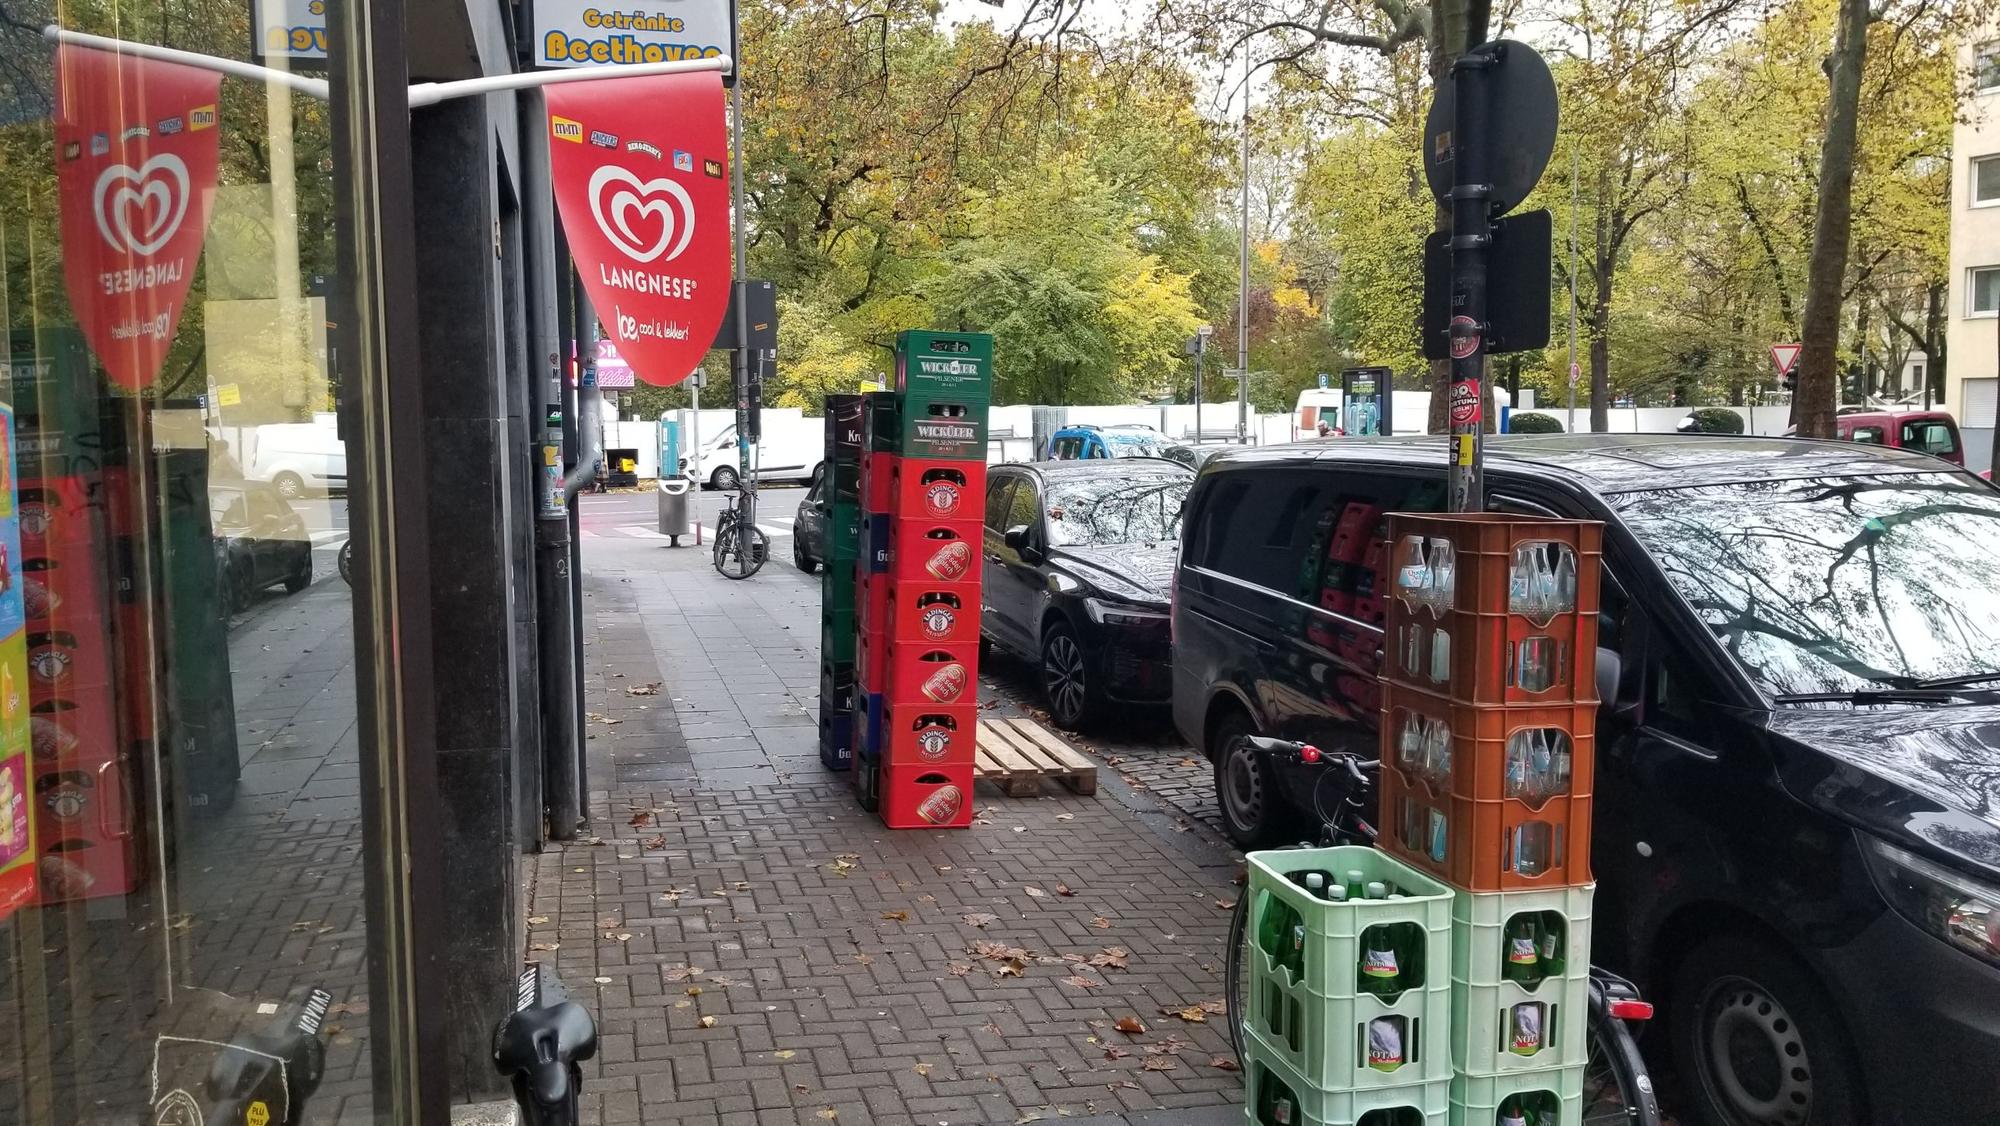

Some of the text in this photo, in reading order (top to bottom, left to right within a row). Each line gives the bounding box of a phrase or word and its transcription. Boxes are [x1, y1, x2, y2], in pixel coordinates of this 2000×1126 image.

[583, 8, 685, 33] Getränke
[545, 30, 722, 64] Beethoven
[640, 316, 654, 336] cool
[656, 322, 662, 338] &
[664, 320, 689, 341] lekker!
[920, 360, 978, 375] WICKLER
[918, 425, 975, 440] WICKÜLER
[928, 486, 958, 498] ERDINGER
[923, 608, 954, 621] ERDINGER
[920, 730, 949, 743] ERDINGER
